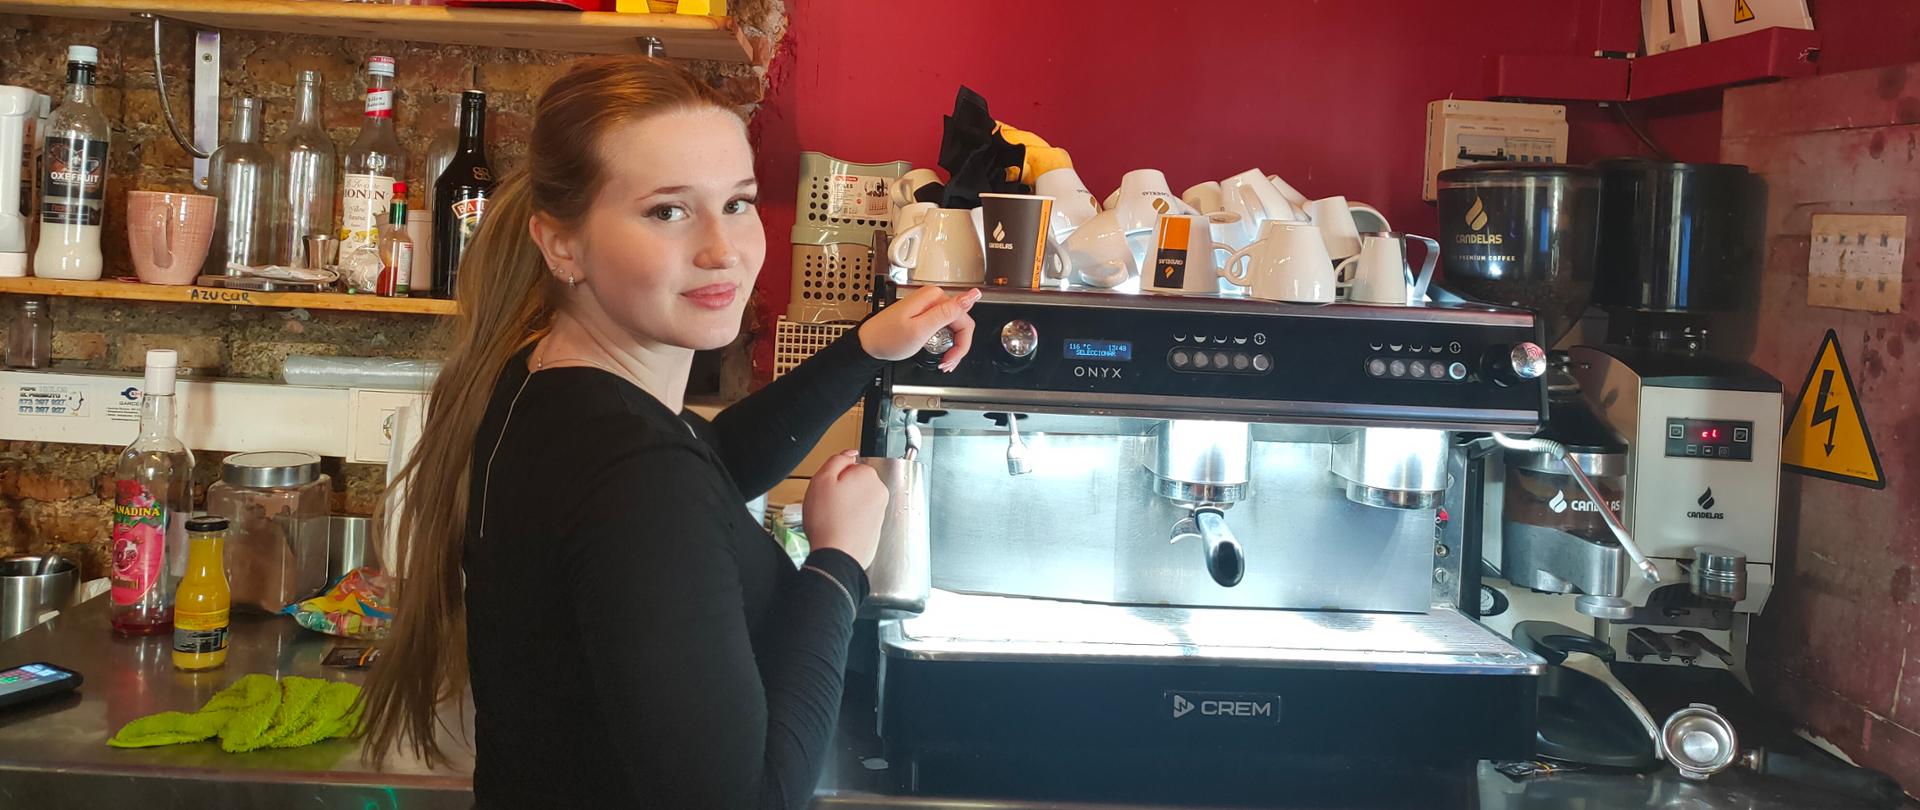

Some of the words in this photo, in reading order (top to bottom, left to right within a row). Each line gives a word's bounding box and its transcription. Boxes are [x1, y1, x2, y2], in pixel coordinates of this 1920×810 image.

[50, 171, 100, 183] OXEFRUIT
[1455, 234, 1503, 245] CANDELAS
[1073, 366, 1122, 379] ONYX
[1686, 511, 1724, 520] CANDELAS
[1201, 701, 1271, 717] CREM
